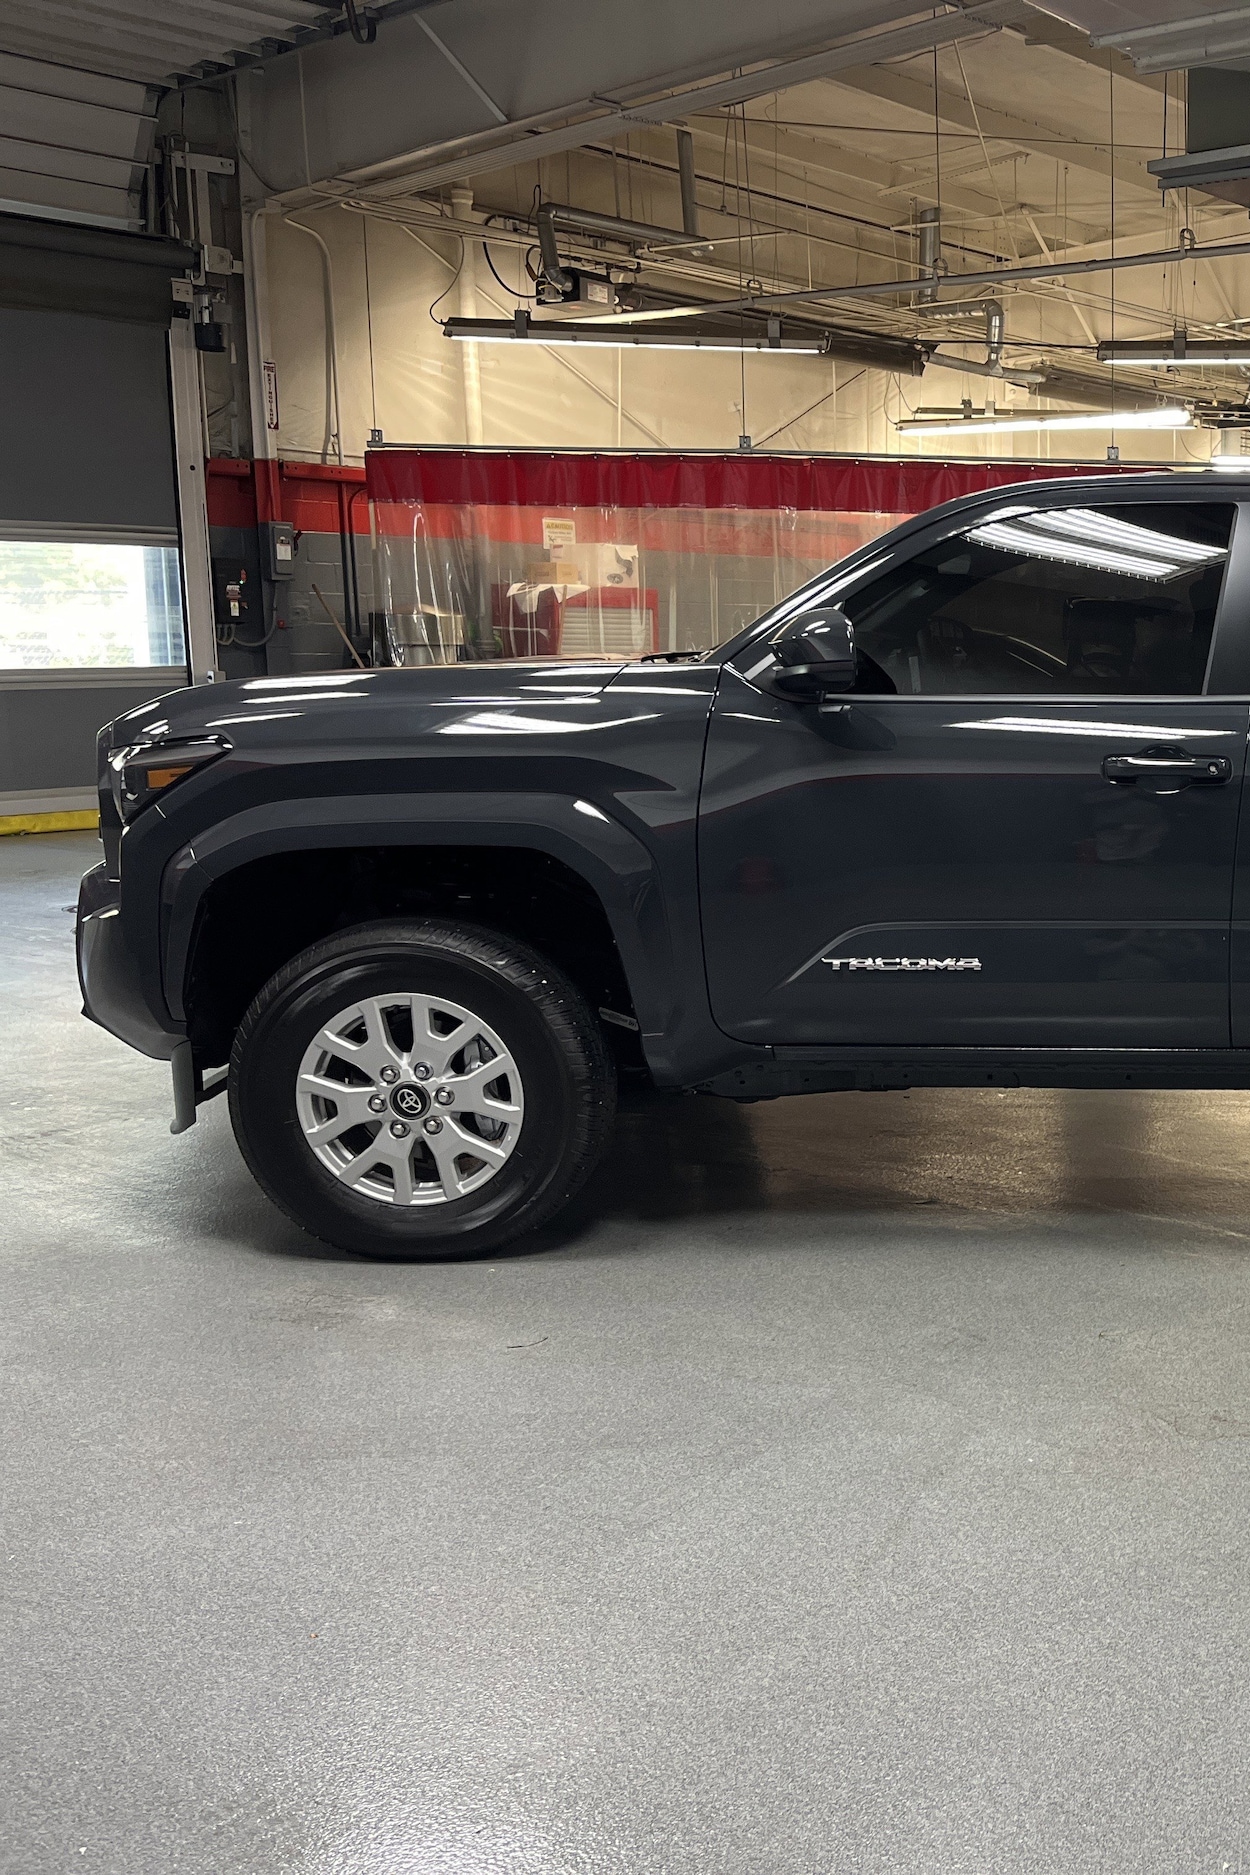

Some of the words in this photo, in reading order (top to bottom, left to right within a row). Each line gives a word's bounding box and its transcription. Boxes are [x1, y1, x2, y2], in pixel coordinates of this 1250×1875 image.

[264, 365, 275, 373] FIRE
[267, 373, 275, 424] EXTINGUISHER
[821, 957, 982, 971] TACOMA
